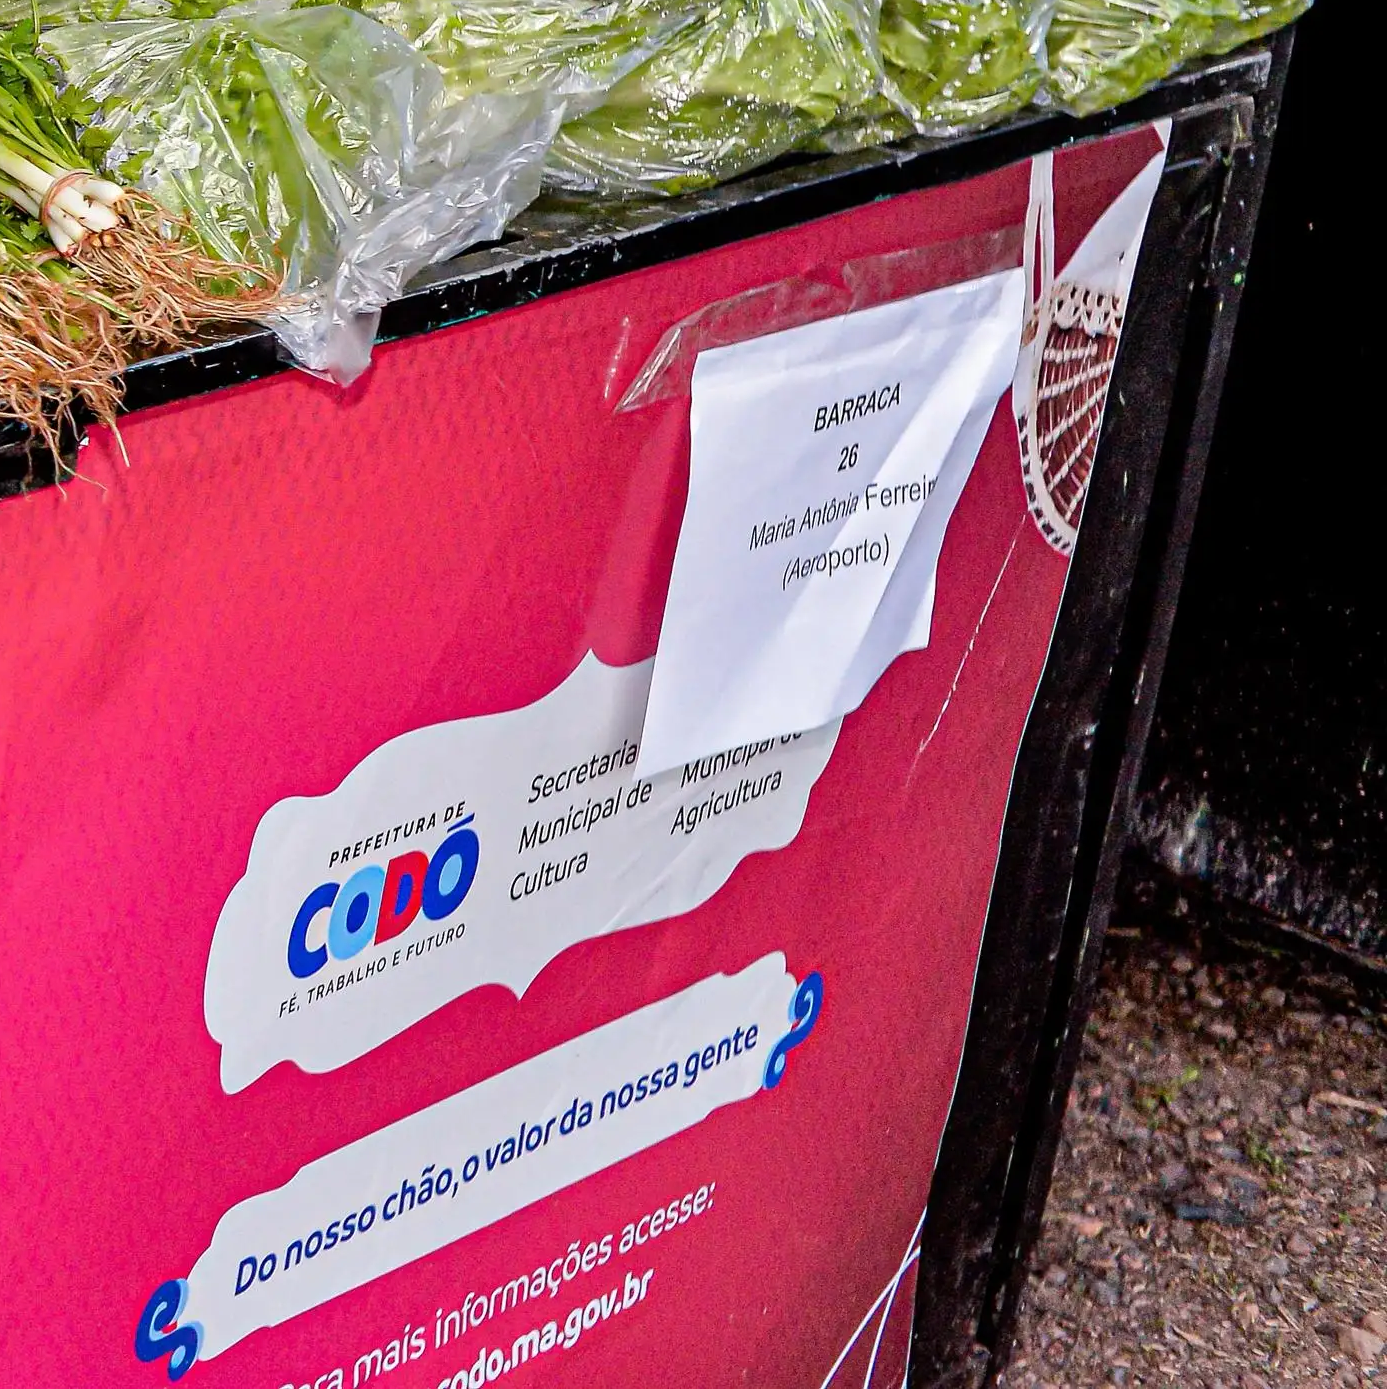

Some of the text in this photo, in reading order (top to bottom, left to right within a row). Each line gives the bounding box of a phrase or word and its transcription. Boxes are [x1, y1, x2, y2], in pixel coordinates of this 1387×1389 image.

[813, 381, 901, 432] BARRACA
[838, 443, 859, 472] 26
[749, 515, 796, 551] Maria
[799, 492, 859, 534] Antônia
[782, 533, 890, 591] (Aeroporto)
[527, 739, 640, 803] Secretaria
[670, 770, 783, 836] Agricultura
[329, 801, 466, 868] PREFEITURA DE
[518, 779, 653, 854] Municipal de
[287, 812, 480, 979] CODÓ
[509, 851, 589, 901] Cultura
[307, 956, 387, 1004] TRABALHO
[392, 949, 401, 967] E
[406, 922, 466, 961] FUTURO
[234, 1024, 759, 1296] Do nosso chão, o valor da nossa gente
[353, 1323, 426, 1389] mais
[434, 1233, 614, 1349] informações
[618, 1182, 716, 1253] acesse:
